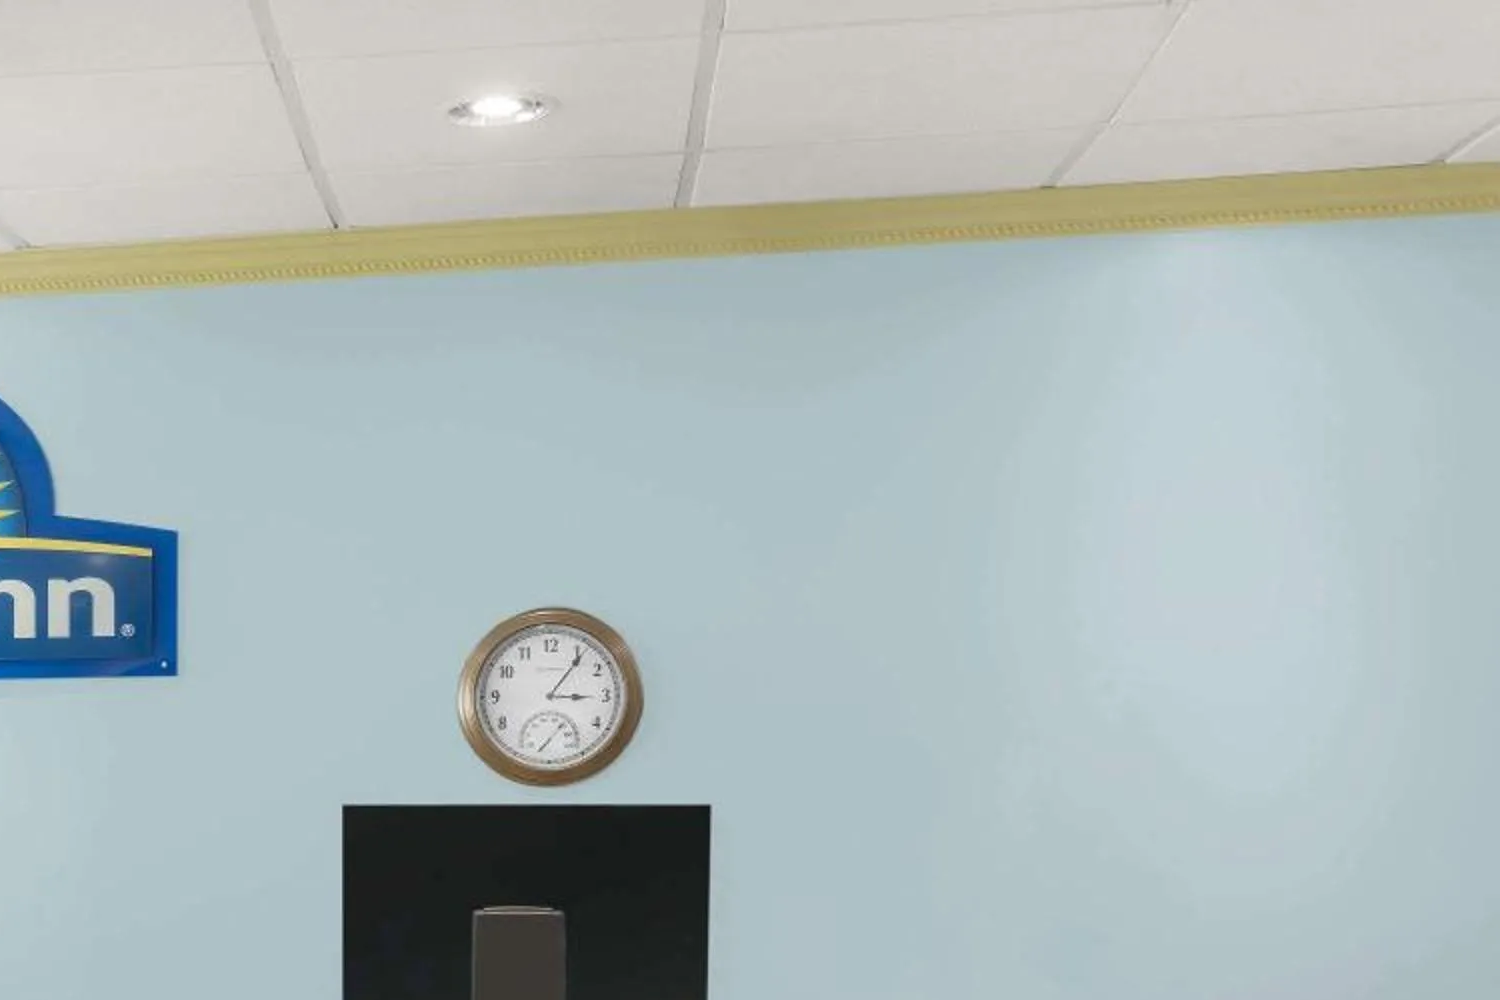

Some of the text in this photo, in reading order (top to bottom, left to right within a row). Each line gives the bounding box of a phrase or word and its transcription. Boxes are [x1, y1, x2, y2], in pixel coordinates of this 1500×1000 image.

[544, 639, 558, 652] 12
[518, 647, 531, 660] 11
[500, 665, 514, 678] 10
[592, 664, 601, 677] 2
[491, 690, 500, 704] 9
[601, 688, 611, 703] 3
[498, 716, 507, 729] 8
[592, 716, 601, 728] 4
